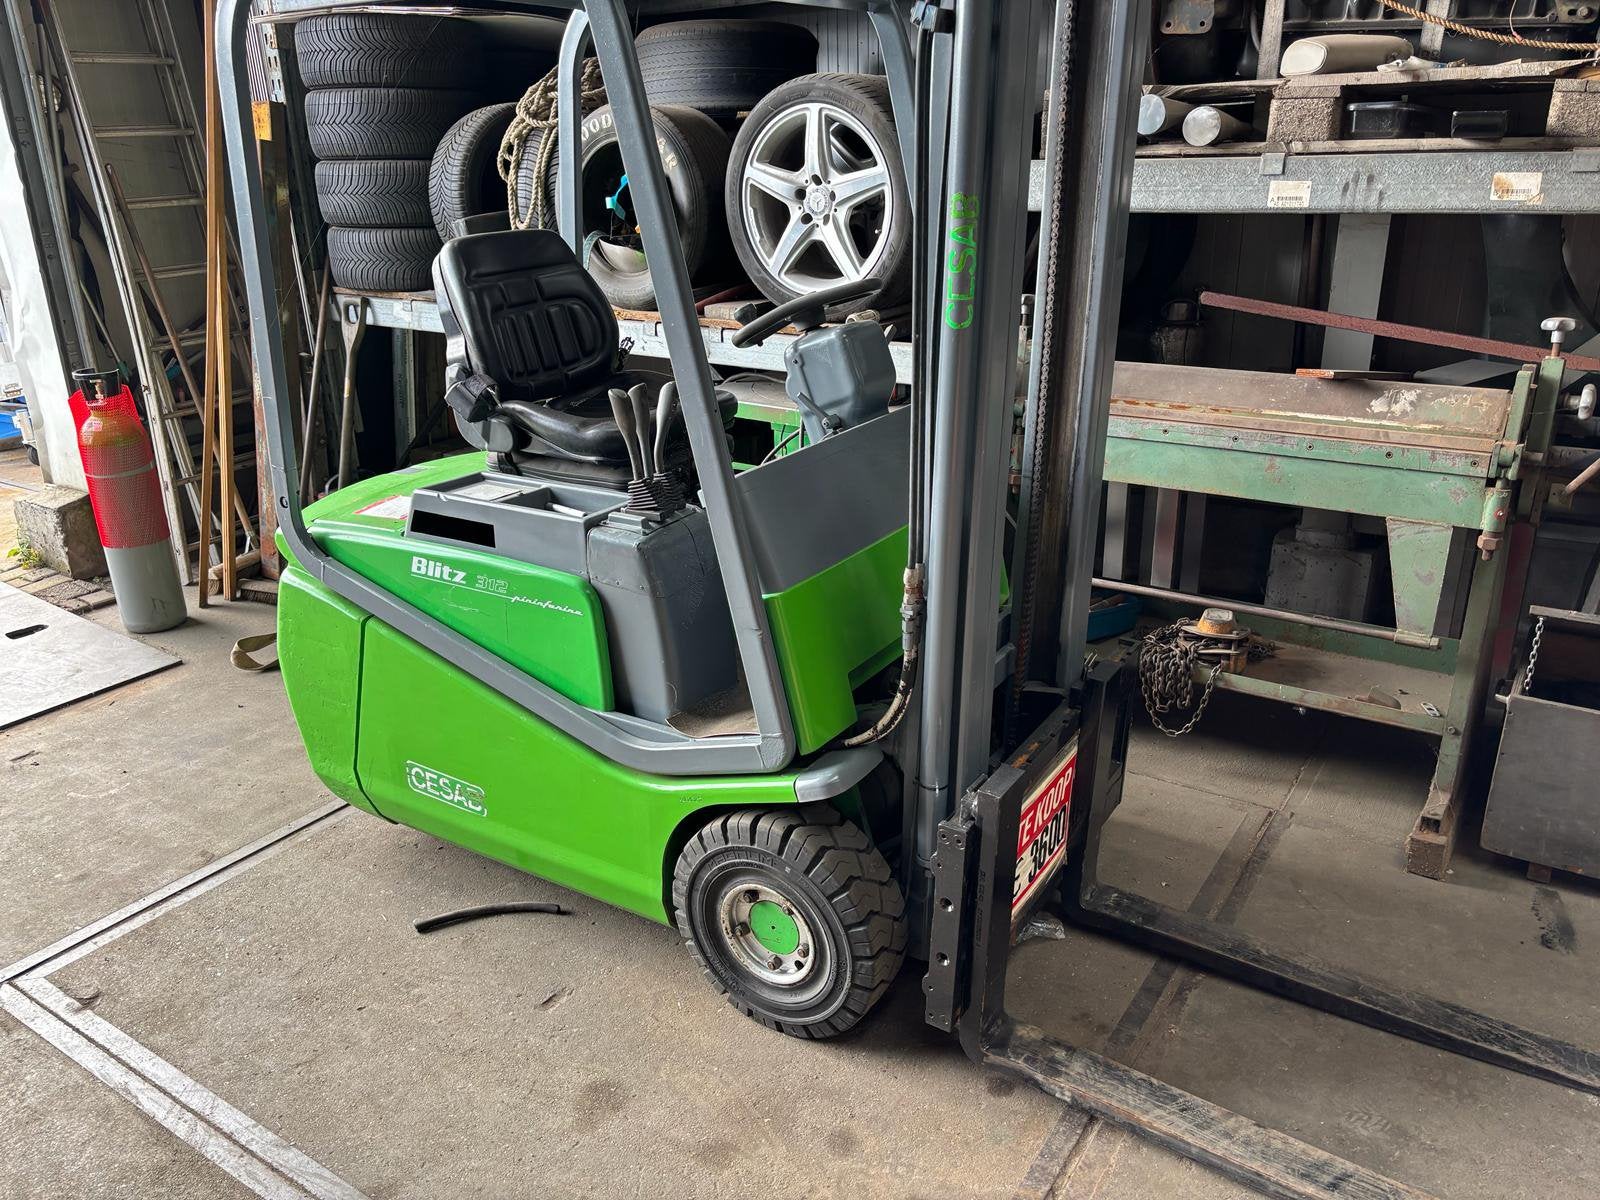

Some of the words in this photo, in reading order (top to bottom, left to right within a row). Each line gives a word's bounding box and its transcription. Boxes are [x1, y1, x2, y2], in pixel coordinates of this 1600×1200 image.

[411, 556, 467, 585] Blitz
[475, 574, 509, 594] 312
[1033, 766, 1073, 834] KOOP
[1028, 804, 1068, 884] 3600
